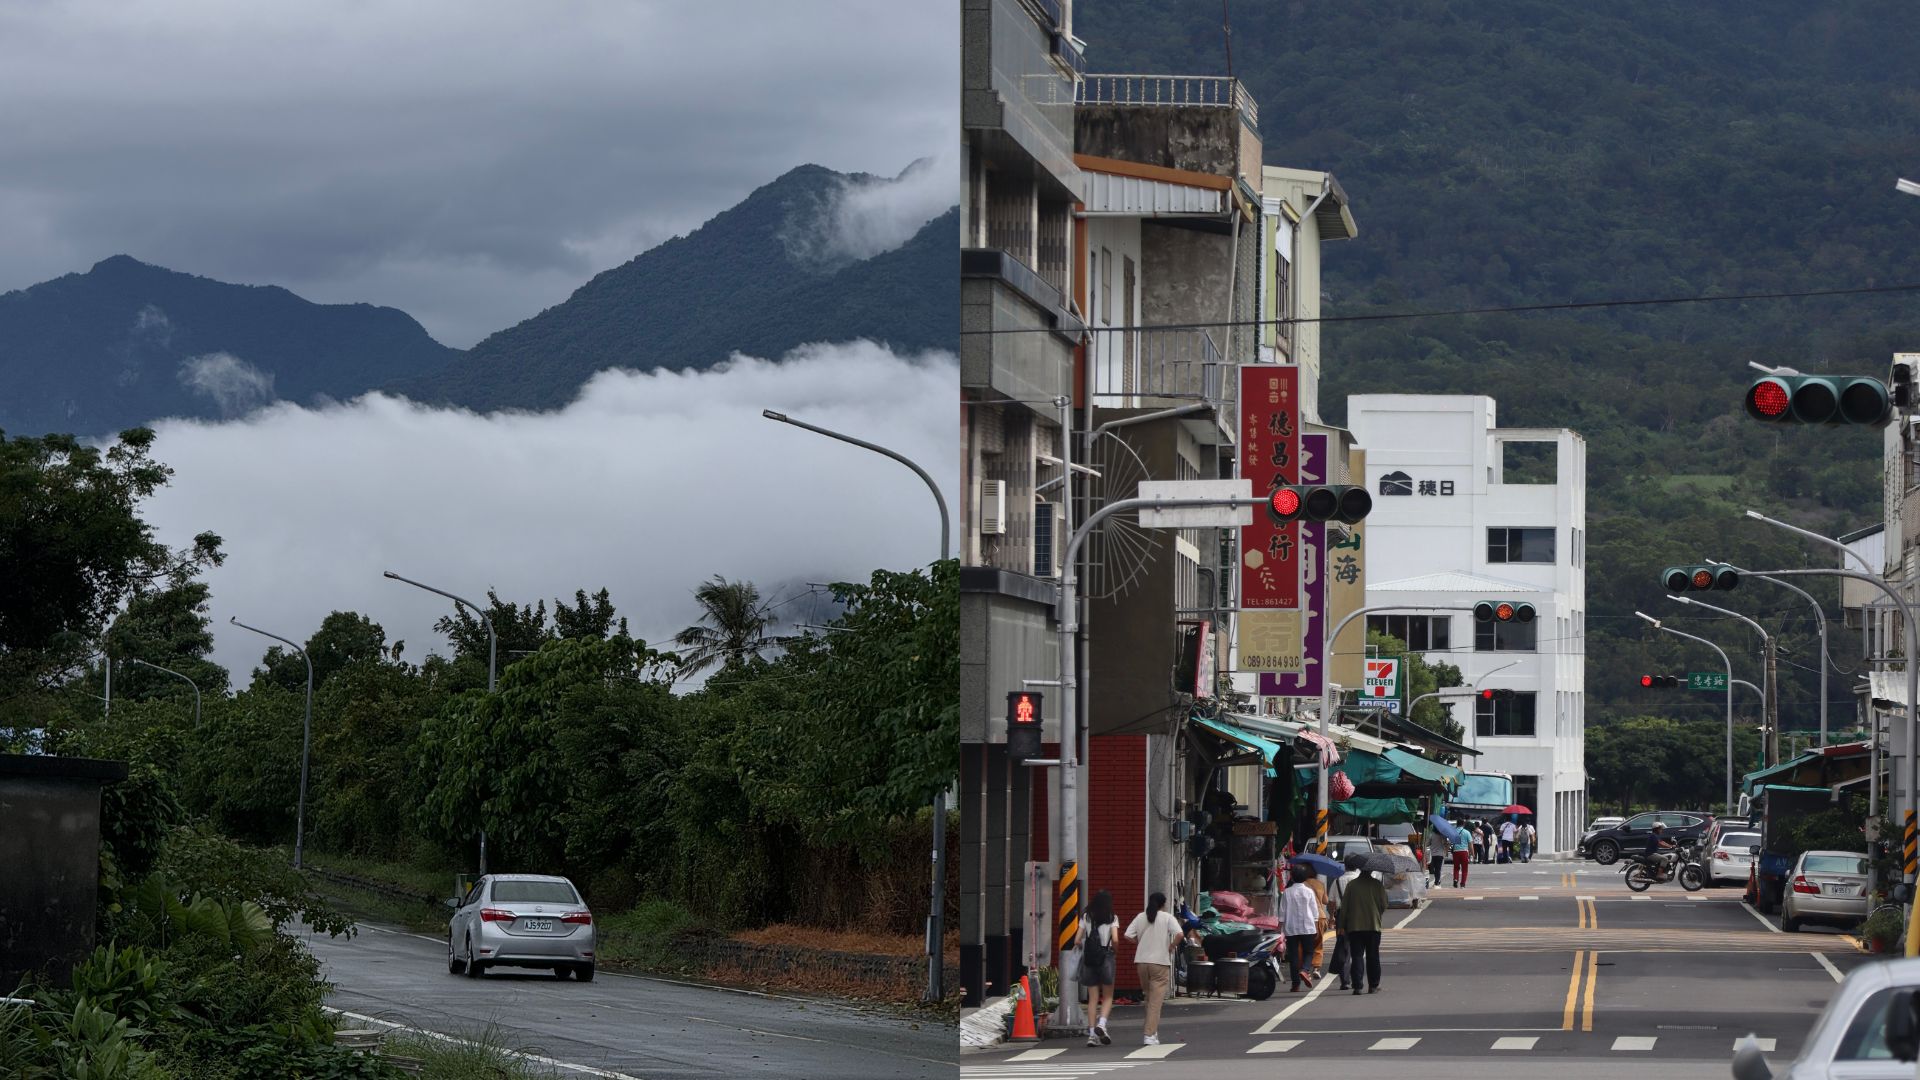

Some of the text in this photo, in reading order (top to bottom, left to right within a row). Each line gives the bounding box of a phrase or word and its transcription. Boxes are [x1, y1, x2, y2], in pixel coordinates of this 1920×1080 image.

[1694, 674, 1724, 687] 忠孝路
[1389, 702, 1398, 711] P
